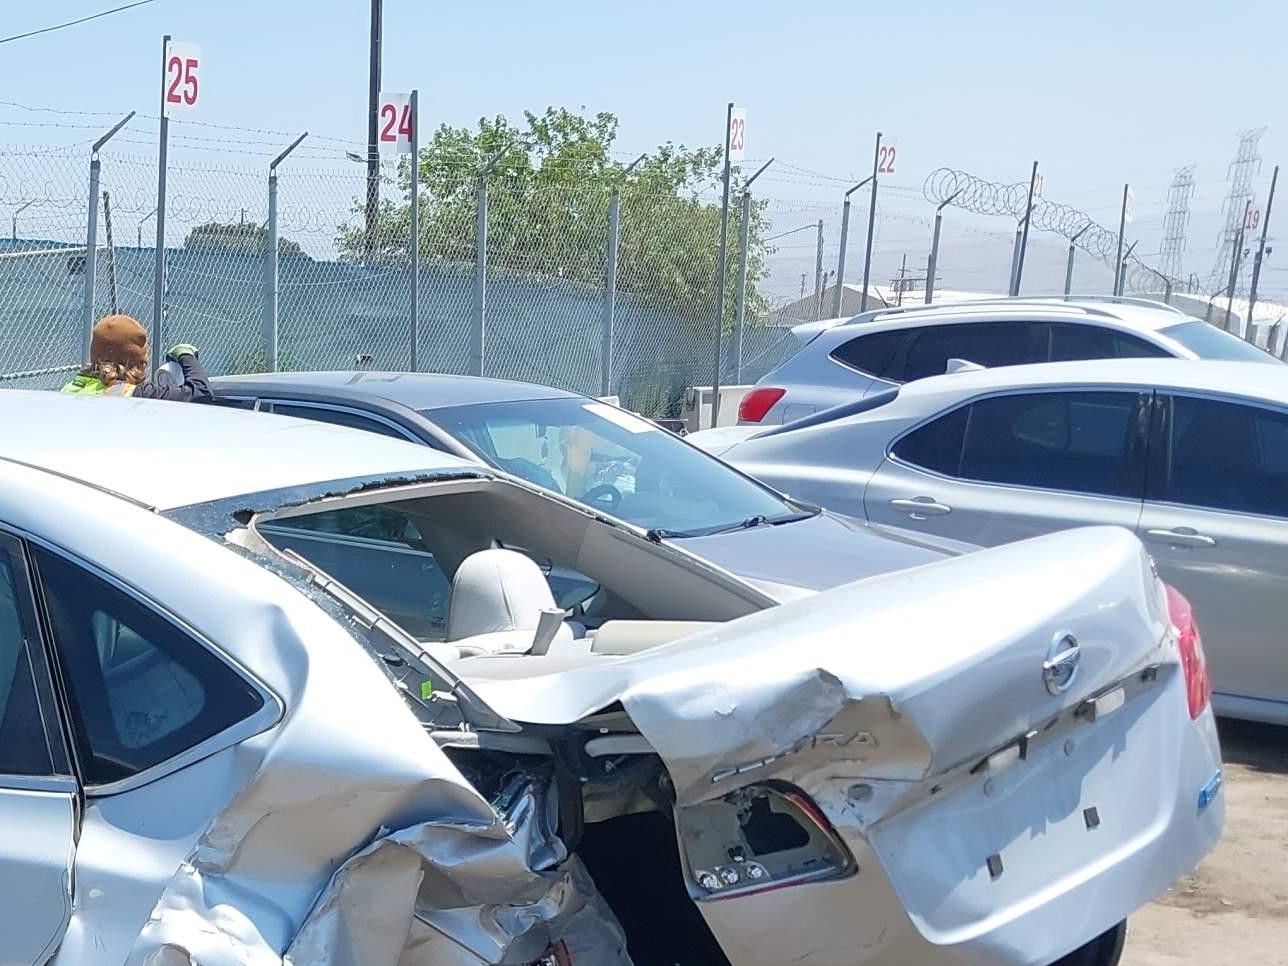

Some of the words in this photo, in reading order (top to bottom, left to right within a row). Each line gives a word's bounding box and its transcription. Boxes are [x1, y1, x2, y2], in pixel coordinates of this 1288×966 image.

[167, 56, 198, 105] 25
[381, 104, 413, 143] 24
[731, 118, 744, 150] 23
[878, 146, 896, 173] 22
[1245, 210, 1260, 229] 19
